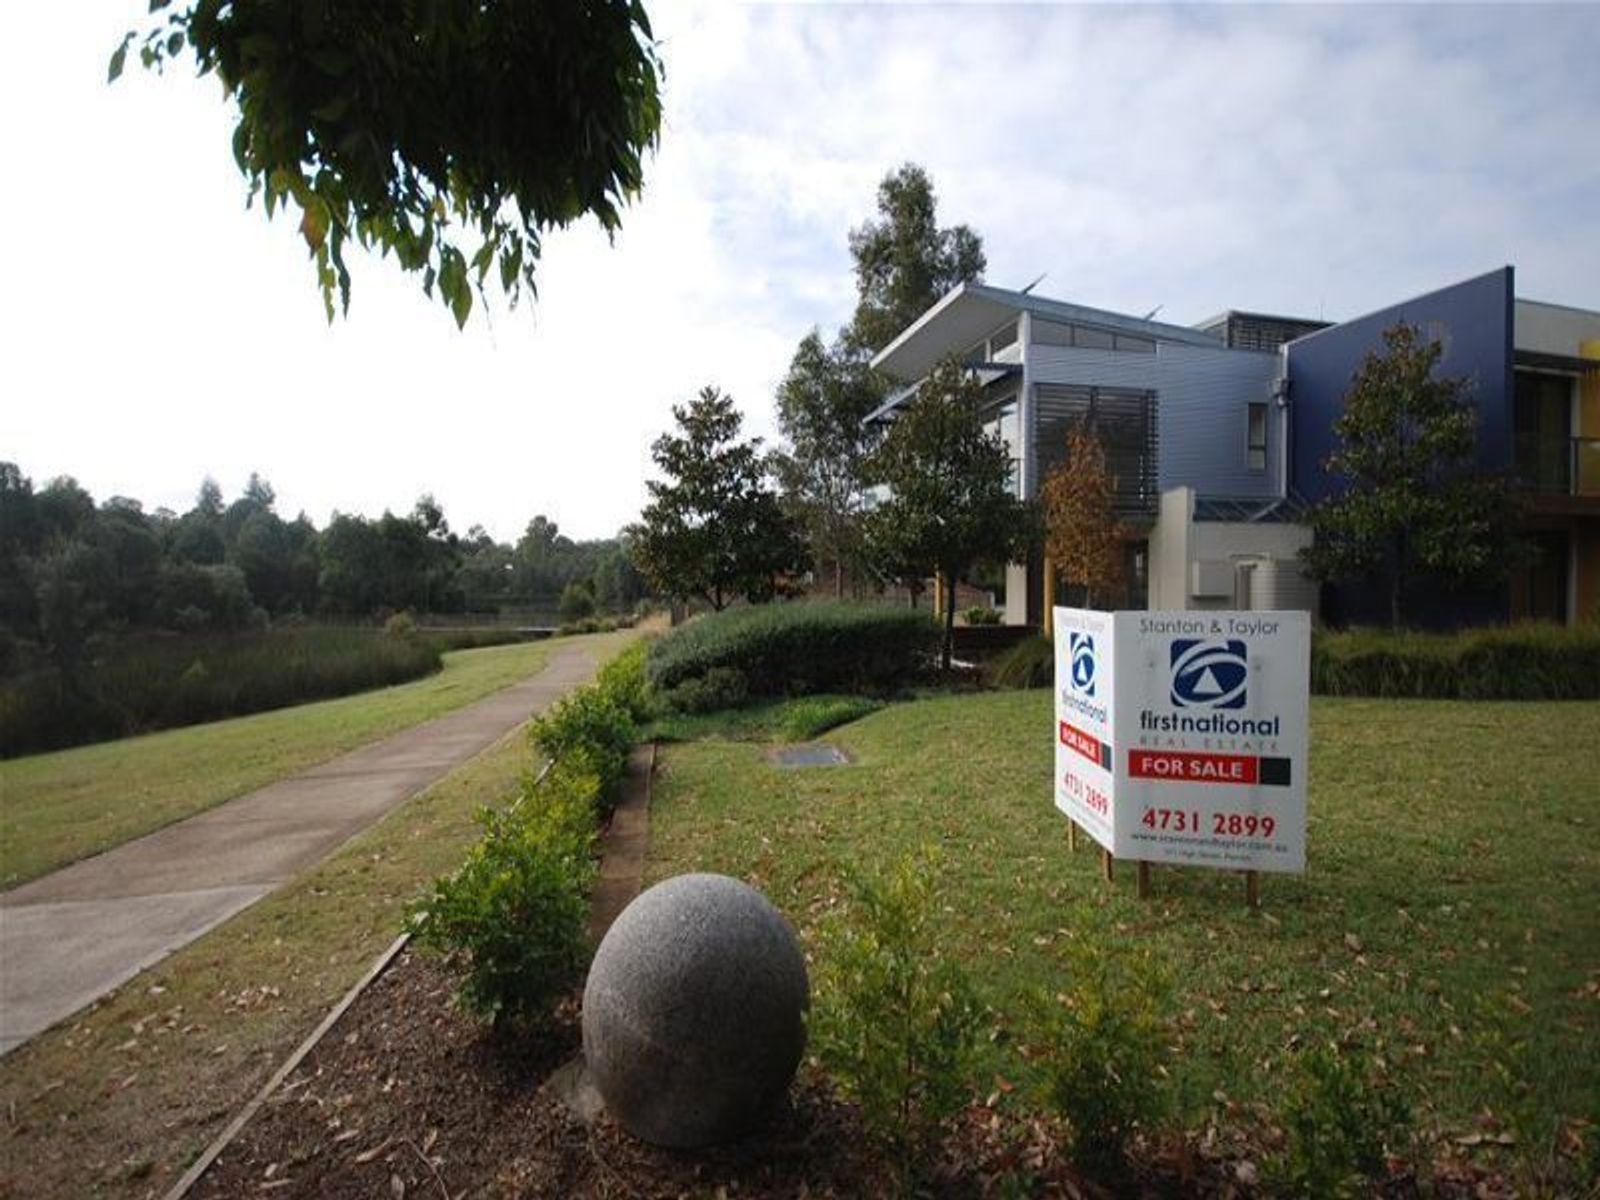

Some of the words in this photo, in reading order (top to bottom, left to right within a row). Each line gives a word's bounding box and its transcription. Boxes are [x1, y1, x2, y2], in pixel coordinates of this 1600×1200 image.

[1140, 619, 1203, 634] Stanton
[1210, 620, 1222, 633] &
[1229, 619, 1279, 636] Taylor
[1140, 736, 1186, 747] REAL
[1204, 738, 1279, 750] ESTATE
[1142, 757, 1184, 775] FOR
[1190, 760, 1243, 778] SALE
[1142, 807, 1199, 832] 4731
[1212, 812, 1276, 838] 2899
